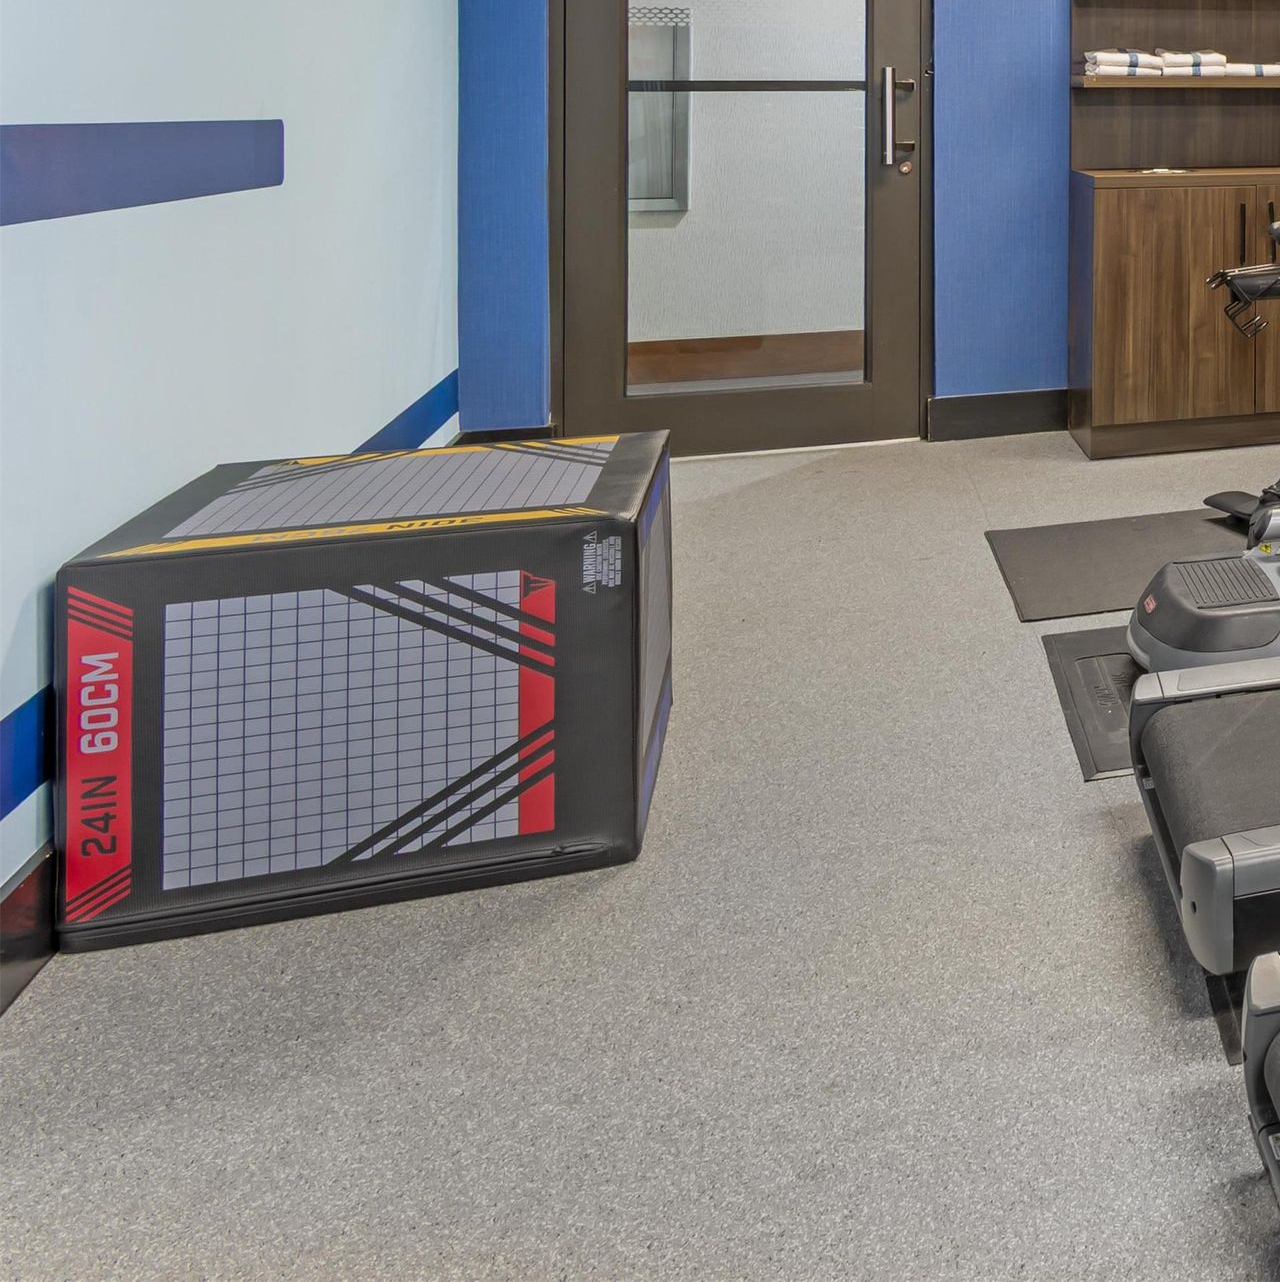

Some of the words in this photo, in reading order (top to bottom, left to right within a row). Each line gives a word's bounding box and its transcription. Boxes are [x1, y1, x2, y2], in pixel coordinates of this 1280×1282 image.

[583, 543, 596, 584] WARNING
[80, 652, 119, 754] 60CM
[81, 775, 117, 857] 24IN
